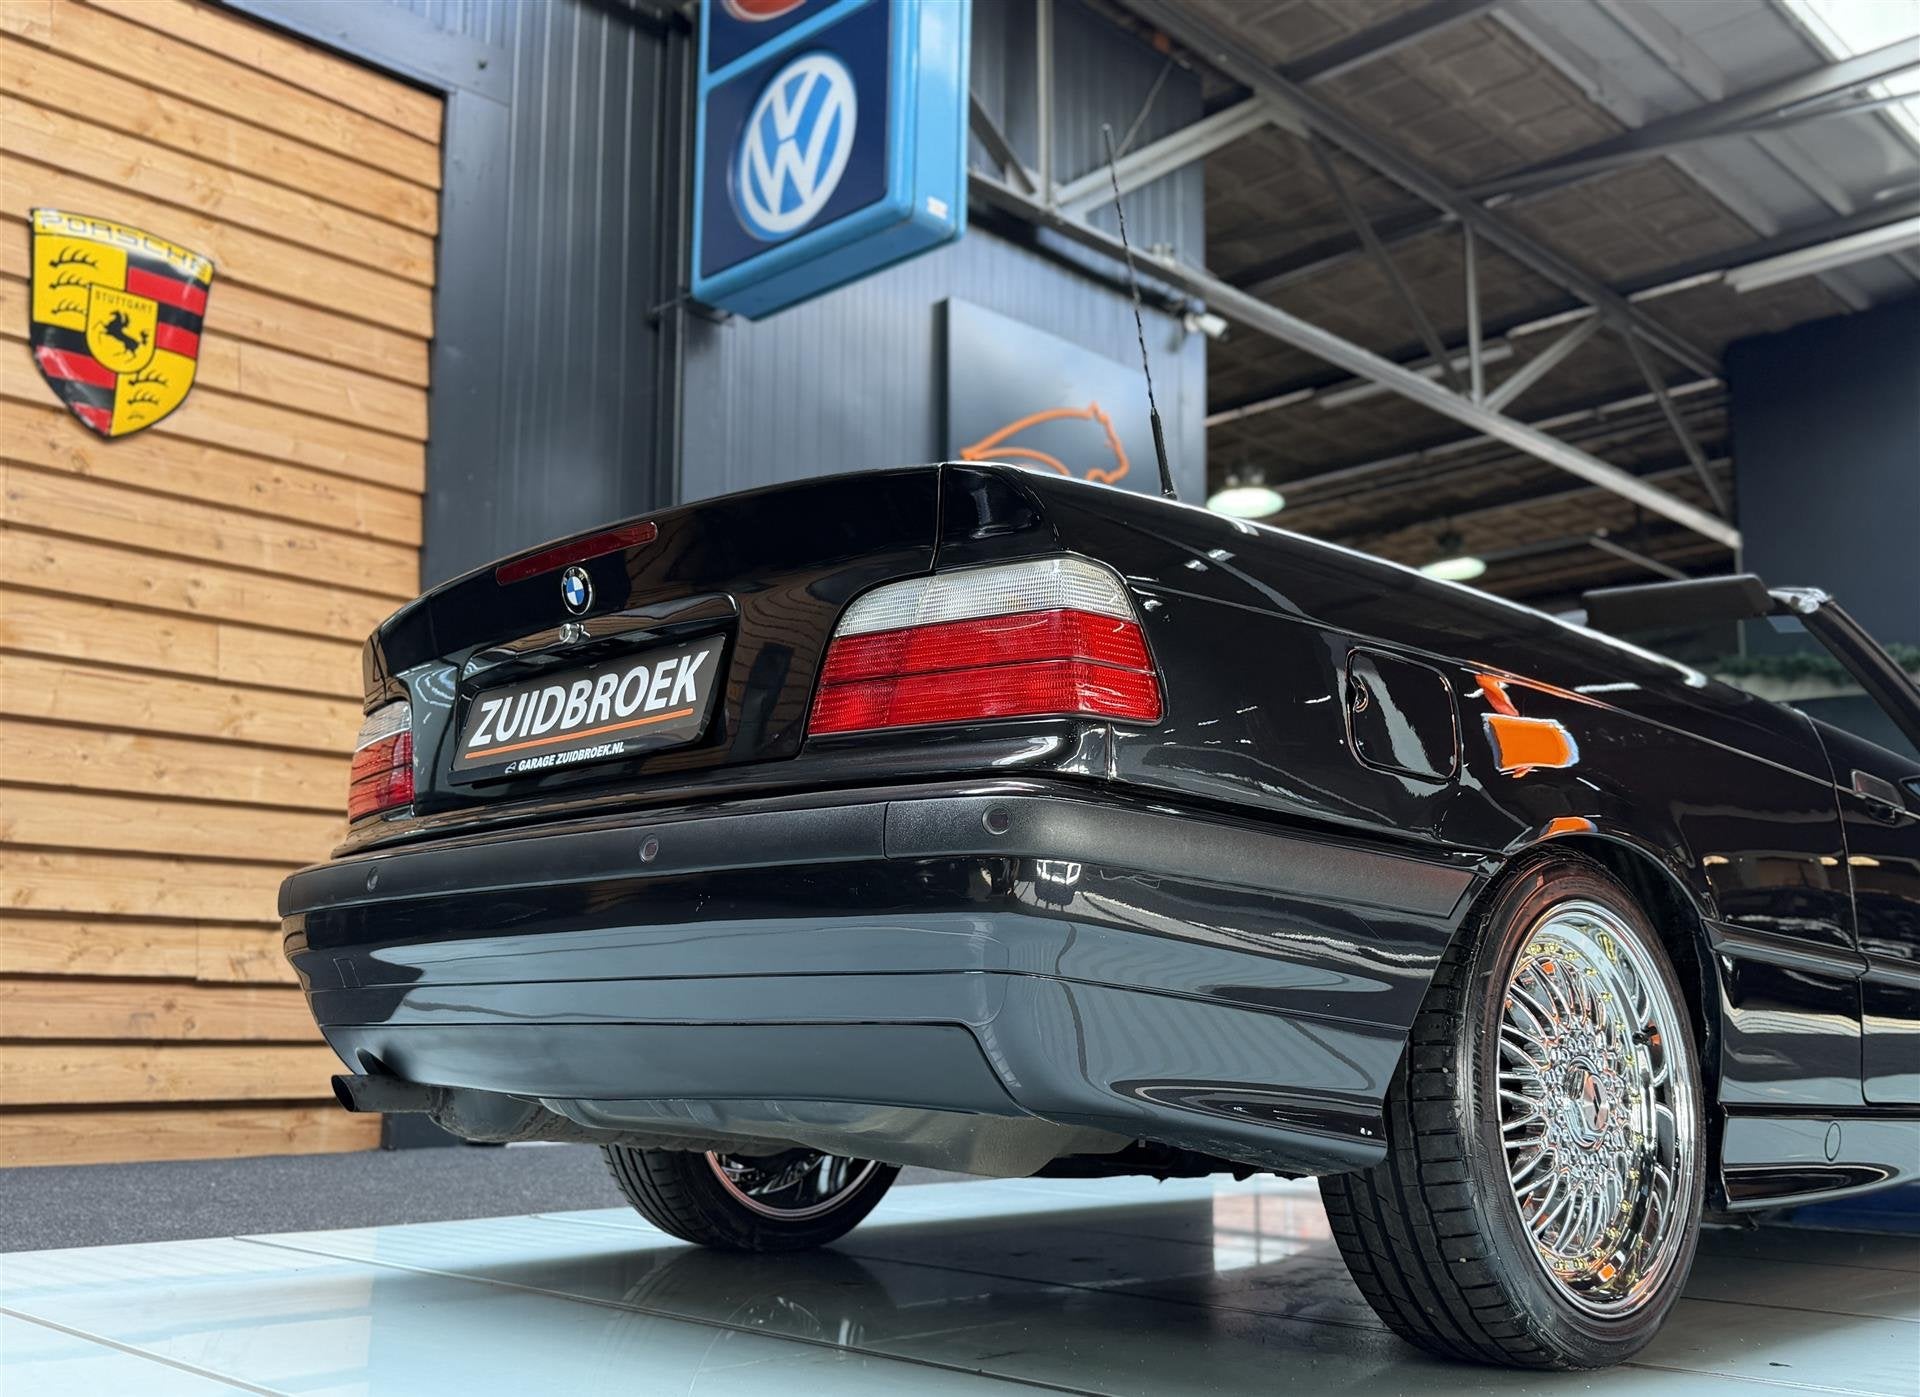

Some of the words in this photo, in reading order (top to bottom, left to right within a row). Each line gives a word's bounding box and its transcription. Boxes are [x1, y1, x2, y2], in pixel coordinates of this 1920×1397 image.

[744, 56, 855, 231] VW
[41, 214, 207, 276] PORSCHE
[95, 291, 154, 313] STUTTGART
[563, 568, 585, 585] BMW
[468, 650, 710, 747] ZUIDBROEK
[518, 757, 555, 772] GARAGE
[556, 742, 625, 765] ZUIDBROEK.NL
